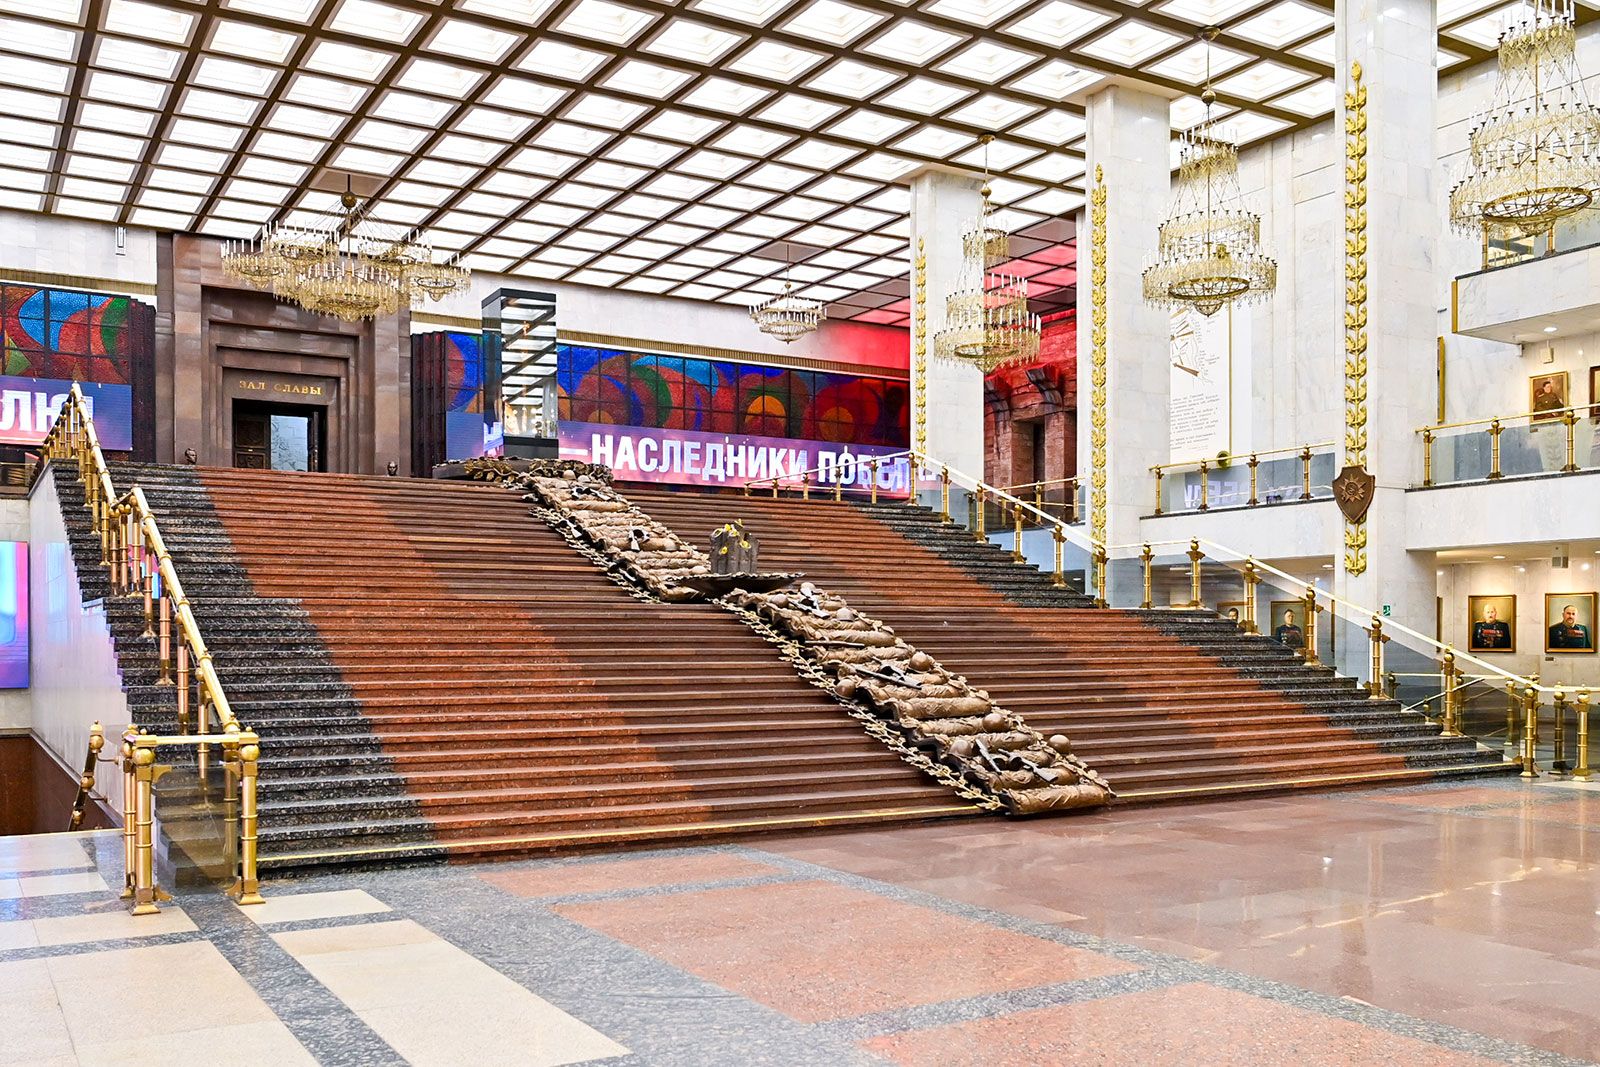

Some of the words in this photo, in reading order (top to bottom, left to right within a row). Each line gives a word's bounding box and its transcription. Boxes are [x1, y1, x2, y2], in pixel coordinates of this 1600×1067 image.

[239, 380, 266, 390] ЗАЛ
[273, 383, 322, 395] СЛАВЫ
[591, 433, 808, 482] НАСЛЕДНИКИ
